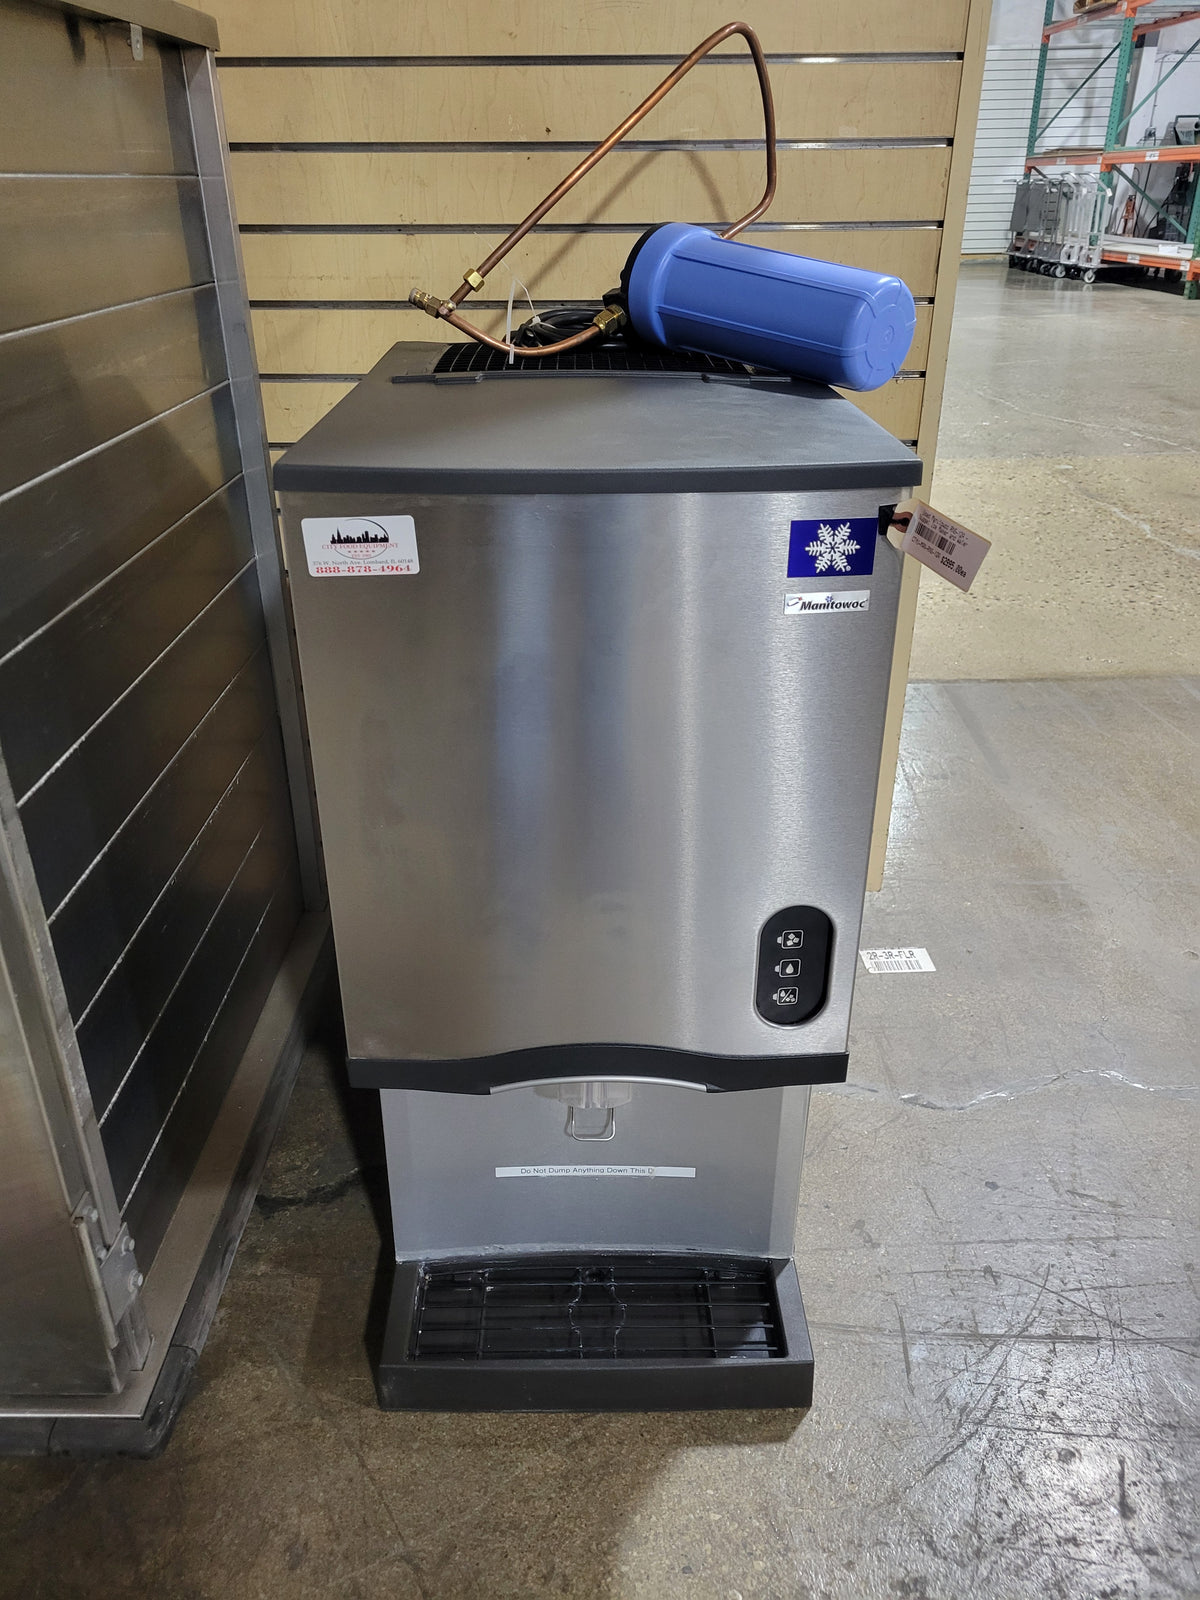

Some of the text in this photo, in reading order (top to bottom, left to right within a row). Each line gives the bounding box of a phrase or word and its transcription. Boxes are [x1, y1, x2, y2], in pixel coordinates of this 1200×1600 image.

[316, 564, 411, 574] 888-878-4964
[800, 601, 866, 611] Manitowoc
[866, 950, 916, 961] 2R-3R-FLR
[572, 1167, 605, 1175] Anything
